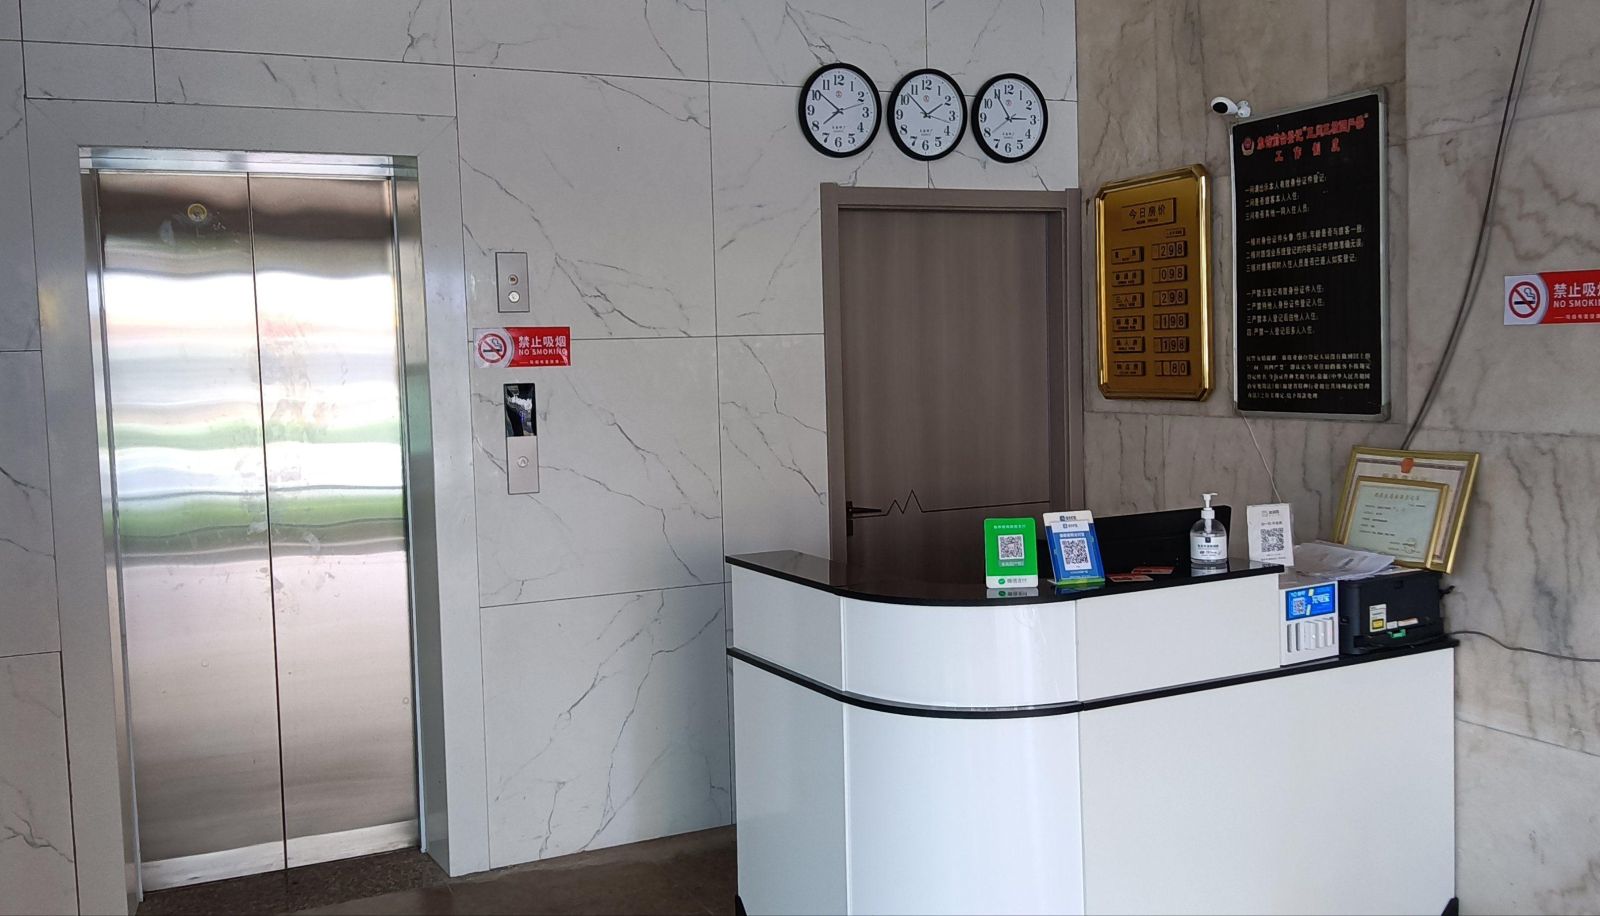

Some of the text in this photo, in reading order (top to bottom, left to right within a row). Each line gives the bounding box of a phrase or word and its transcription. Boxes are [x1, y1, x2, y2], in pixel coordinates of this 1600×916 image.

[822, 79, 830, 91] 11
[833, 74, 844, 86] 12
[921, 79, 932, 90] 12
[850, 81, 854, 92] 1
[910, 84, 918, 96] 11
[937, 85, 941, 96] 1
[1004, 84, 1014, 95] 12
[812, 90, 821, 101] 10
[857, 91, 865, 102] 2
[900, 95, 910, 105] 10
[1019, 90, 1023, 100] 1
[944, 96, 952, 106] 2
[984, 98, 993, 109] 10
[1026, 100, 1033, 110] 2
[807, 105, 815, 116] 9
[862, 107, 870, 118] 3
[896, 109, 904, 120] 9
[948, 110, 956, 121] 3
[980, 112, 987, 123] 9
[1030, 115, 1037, 125] 3
[812, 121, 820, 132] 8
[856, 122, 864, 133] 4
[900, 125, 908, 136] 8
[943, 125, 951, 136] 4
[983, 127, 991, 138] 8
[1025, 128, 1032, 139] 4
[822, 133, 830, 144] 7
[835, 136, 842, 148] 6
[848, 133, 856, 144] 5
[910, 135, 918, 147] 7
[935, 136, 942, 147] 5
[993, 138, 1001, 149] 7
[922, 139, 929, 151] 6
[1005, 143, 1012, 153] 6
[1016, 139, 1023, 150] 5
[1129, 204, 1166, 219] 今日房价
[1161, 243, 1183, 257] 298
[1161, 268, 1183, 280] 098
[1161, 291, 1183, 304] 298
[1553, 300, 1566, 308] NO
[1163, 315, 1184, 327] 198
[518, 335, 566, 348] 禁止吸烟
[1164, 339, 1184, 351] 198
[518, 348, 568, 356] NO SMOKING
[1172, 362, 1186, 373] 80
